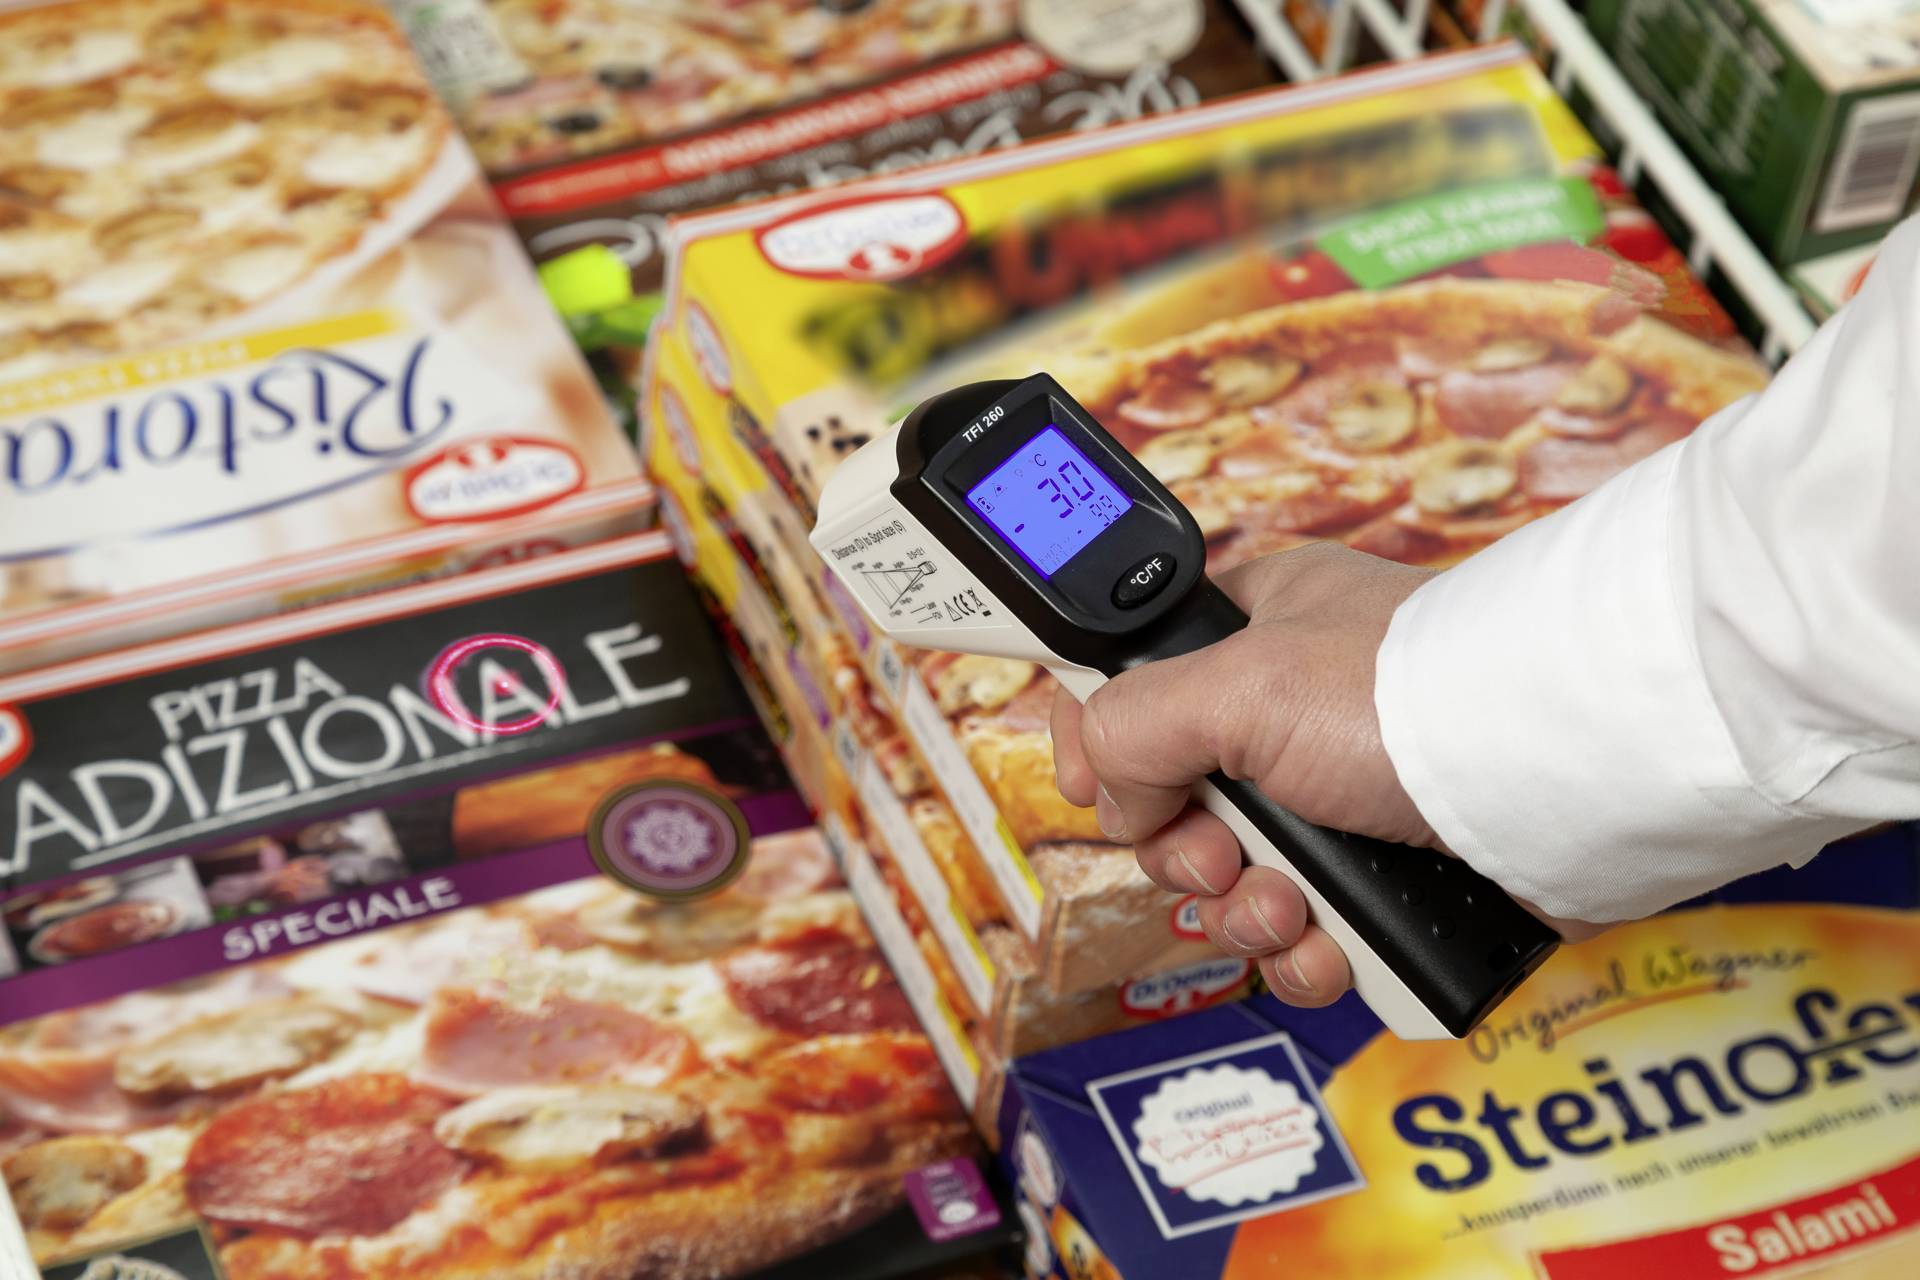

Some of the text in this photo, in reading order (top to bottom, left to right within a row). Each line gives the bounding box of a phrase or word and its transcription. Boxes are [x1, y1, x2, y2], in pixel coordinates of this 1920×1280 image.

[962, 405, 1005, 442] TFI 260
[1130, 557, 1162, 585] °C/°F
[151, 658, 347, 740] PIZZA
[0, 623, 690, 877] ADIZIONALE
[222, 877, 462, 962] SPECIALE
[1468, 945, 1819, 1065] Original Wagner
[1391, 986, 1920, 1194] Steinofe
[1706, 1180, 1898, 1273] Salami
